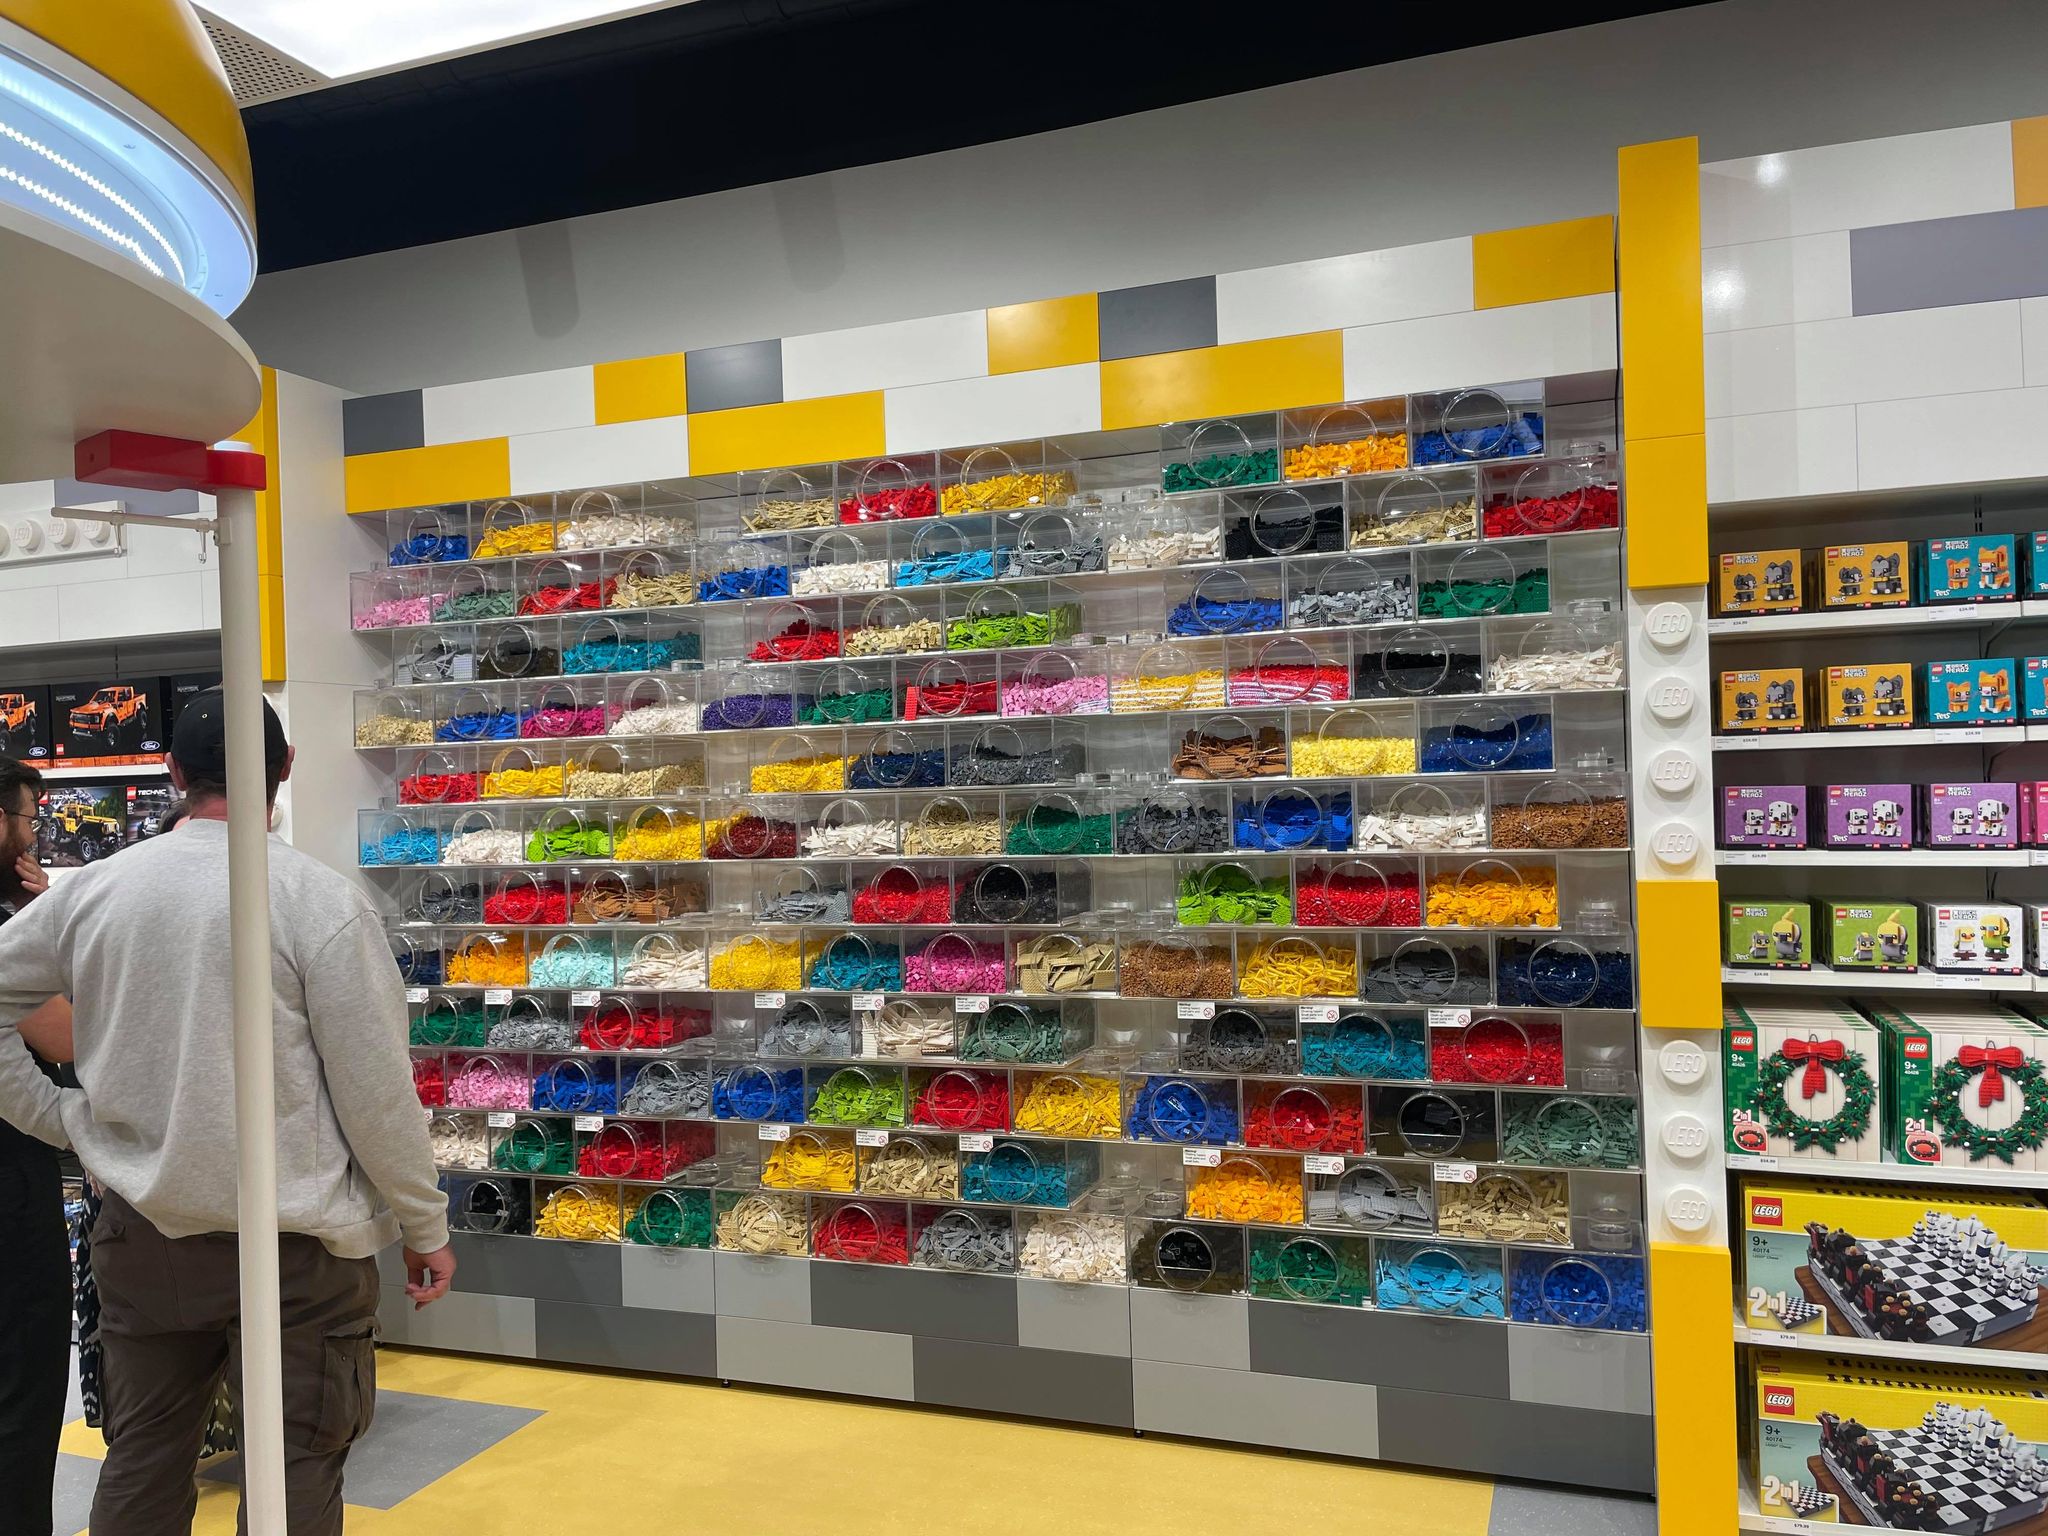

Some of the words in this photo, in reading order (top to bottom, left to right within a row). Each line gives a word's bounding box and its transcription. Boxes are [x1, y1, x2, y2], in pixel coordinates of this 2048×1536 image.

[1651, 614, 1688, 634] LEGO
[1653, 688, 1688, 707] LEGO
[1655, 761, 1691, 780] LEGO
[1658, 834, 1693, 853] LEGO
[1733, 1036, 1752, 1045] LEGO
[1906, 1042, 1926, 1052] LEGO
[1665, 1053, 1701, 1073] LEGO
[1731, 1053, 1743, 1062] 9+
[1904, 1061, 1917, 1069] 9+
[1668, 1127, 1704, 1146] LEGO
[1671, 1200, 1707, 1220] LEGO
[1754, 1205, 1780, 1216] LEGO
[1752, 1236, 1768, 1246] 9+
[1767, 1394, 1792, 1406] LEGO
[1765, 1425, 1780, 1435] 9+
